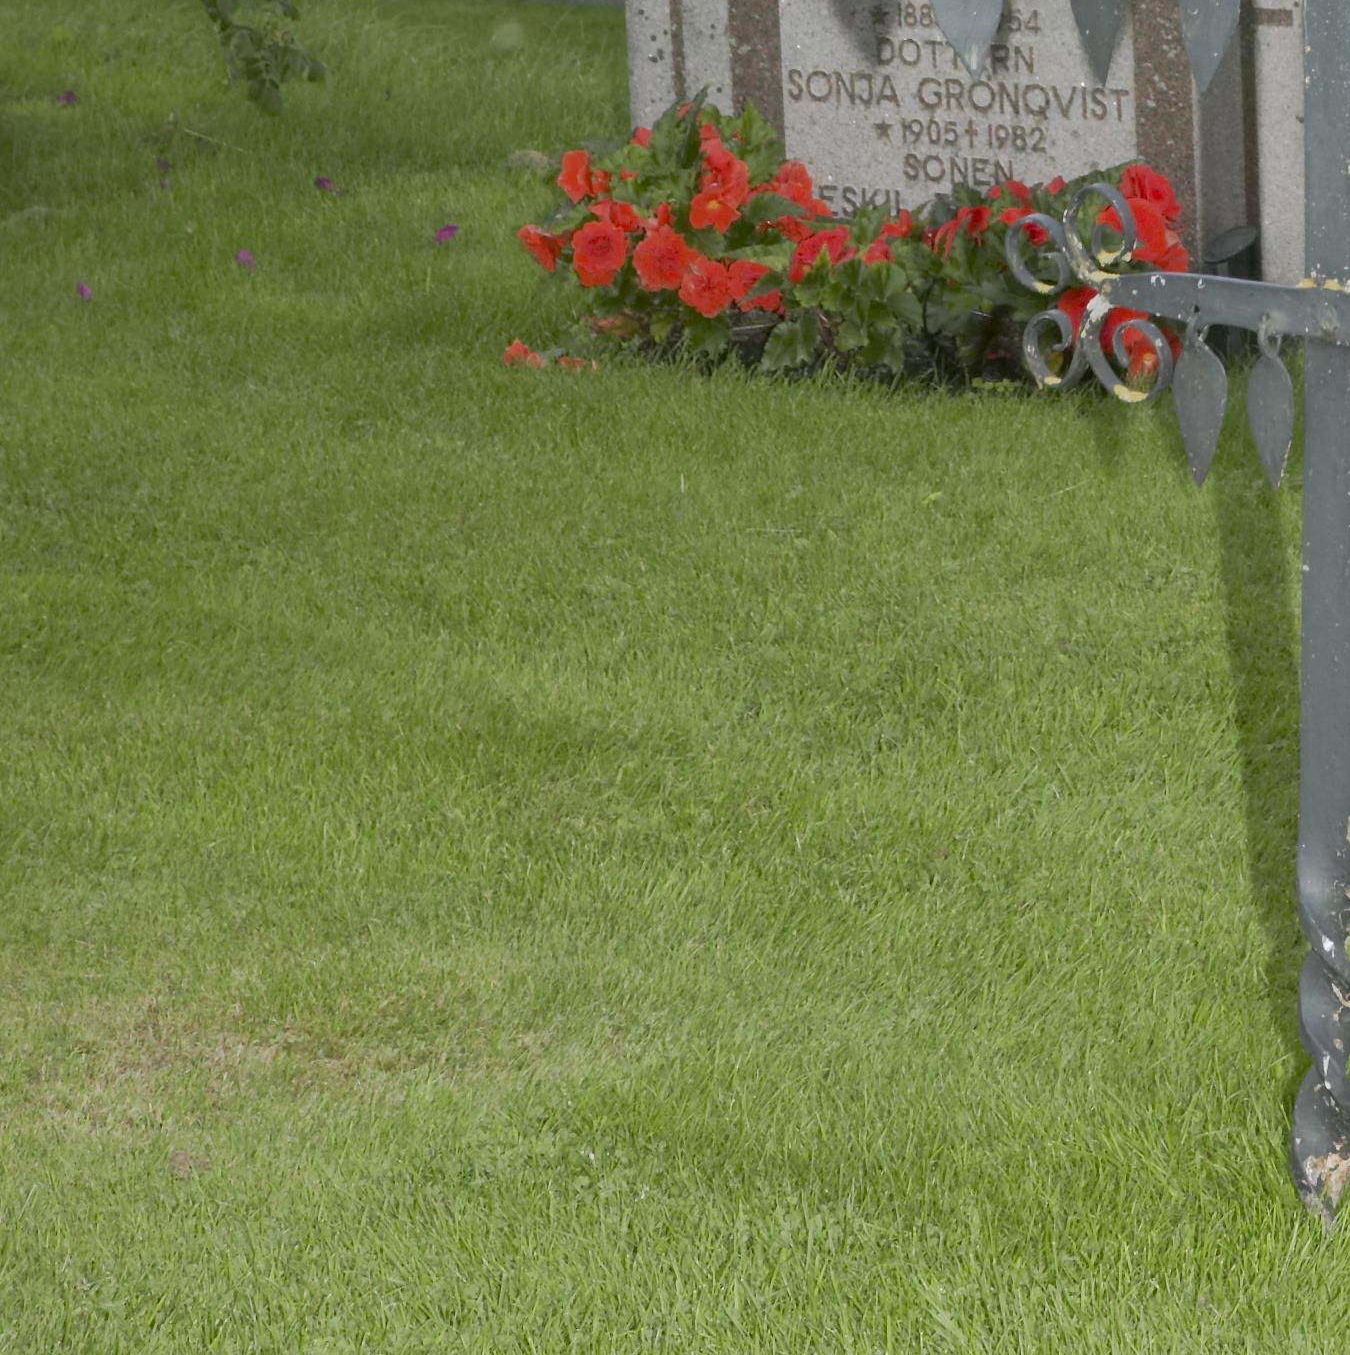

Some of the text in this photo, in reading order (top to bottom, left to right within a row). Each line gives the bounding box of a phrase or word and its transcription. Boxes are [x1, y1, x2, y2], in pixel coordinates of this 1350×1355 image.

[876, 37, 1035, 75] DOTTRN
[788, 68, 901, 108] SONJA
[901, 117, 1047, 153] 1905 1982
[903, 153, 1014, 187] SONEN
